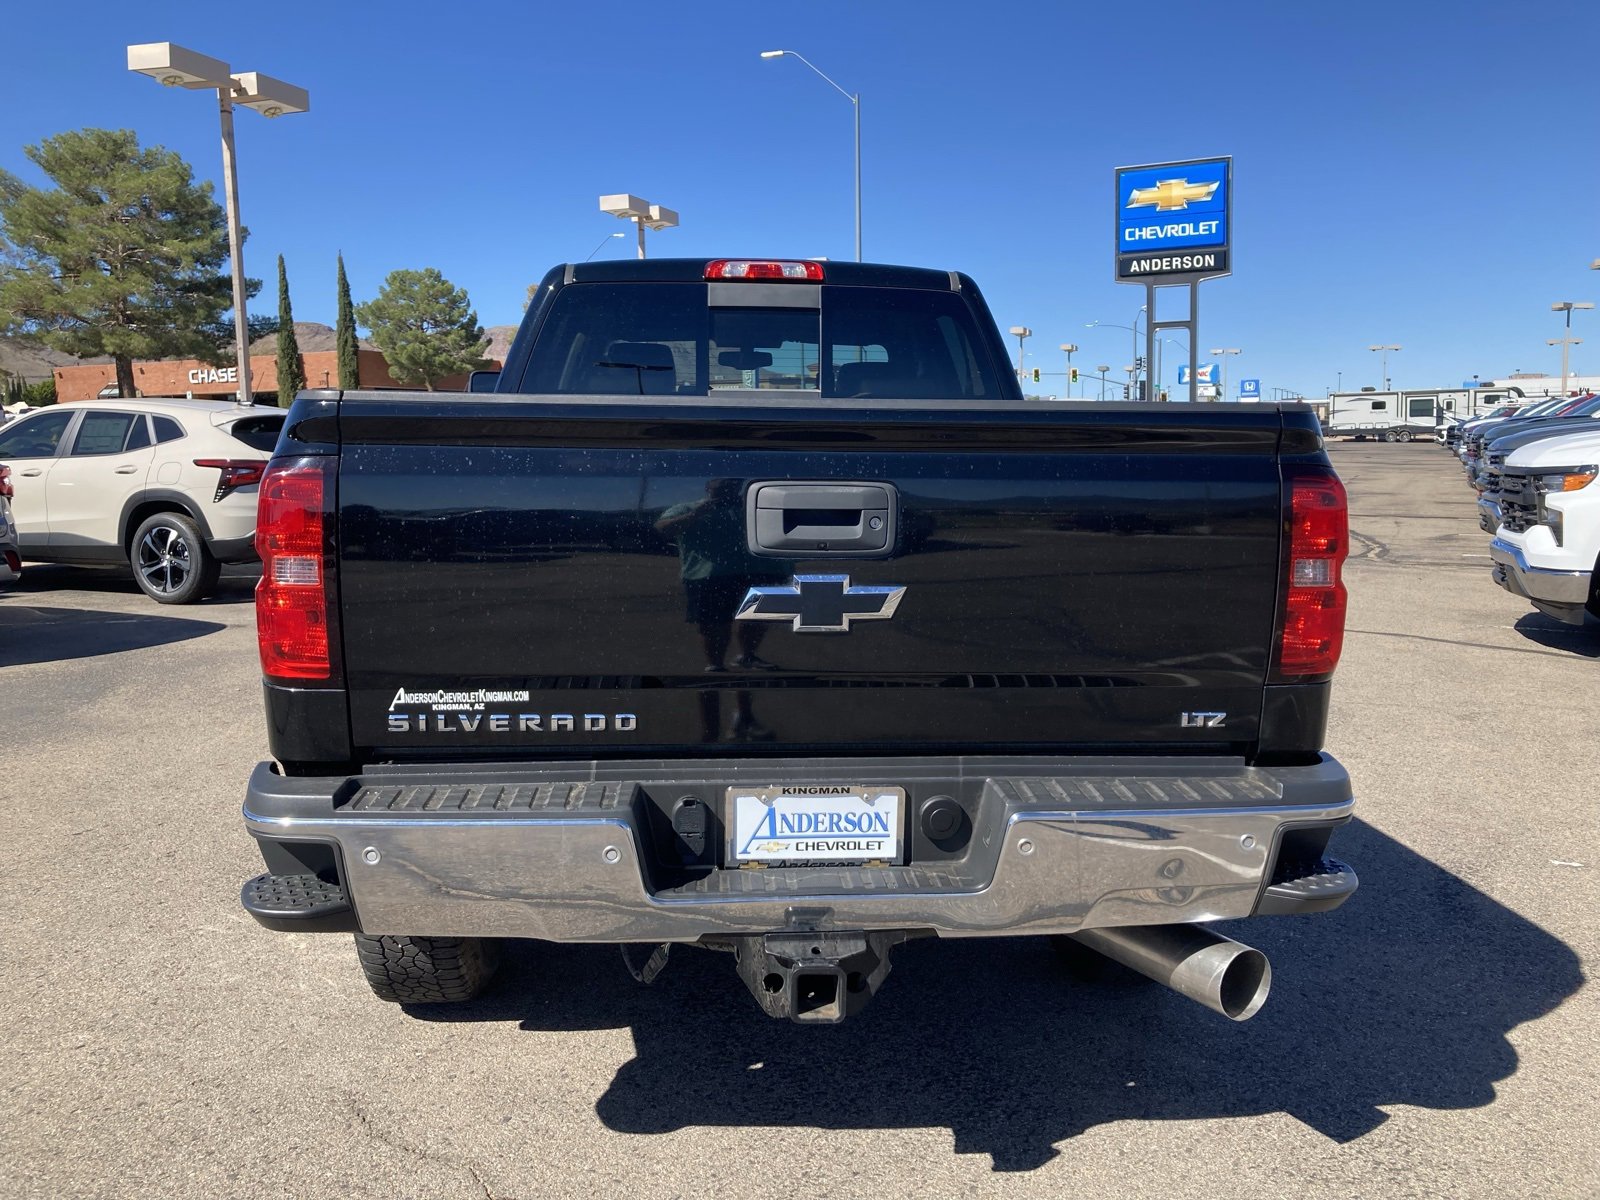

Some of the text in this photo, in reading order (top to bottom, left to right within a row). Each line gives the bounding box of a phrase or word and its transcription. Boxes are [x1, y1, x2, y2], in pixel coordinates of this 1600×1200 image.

[1124, 220, 1220, 241] CHEVROLET
[1130, 254, 1215, 272] ANDERSON
[188, 367, 238, 384] CHASE
[432, 702, 485, 711] KINGMAN, AZ
[388, 714, 637, 732] SILVERADO
[1181, 711, 1227, 728] LTZ
[782, 787, 851, 795] KINGMAN
[738, 806, 891, 855] ANDERSON
[795, 840, 884, 852] CHEVROLET
